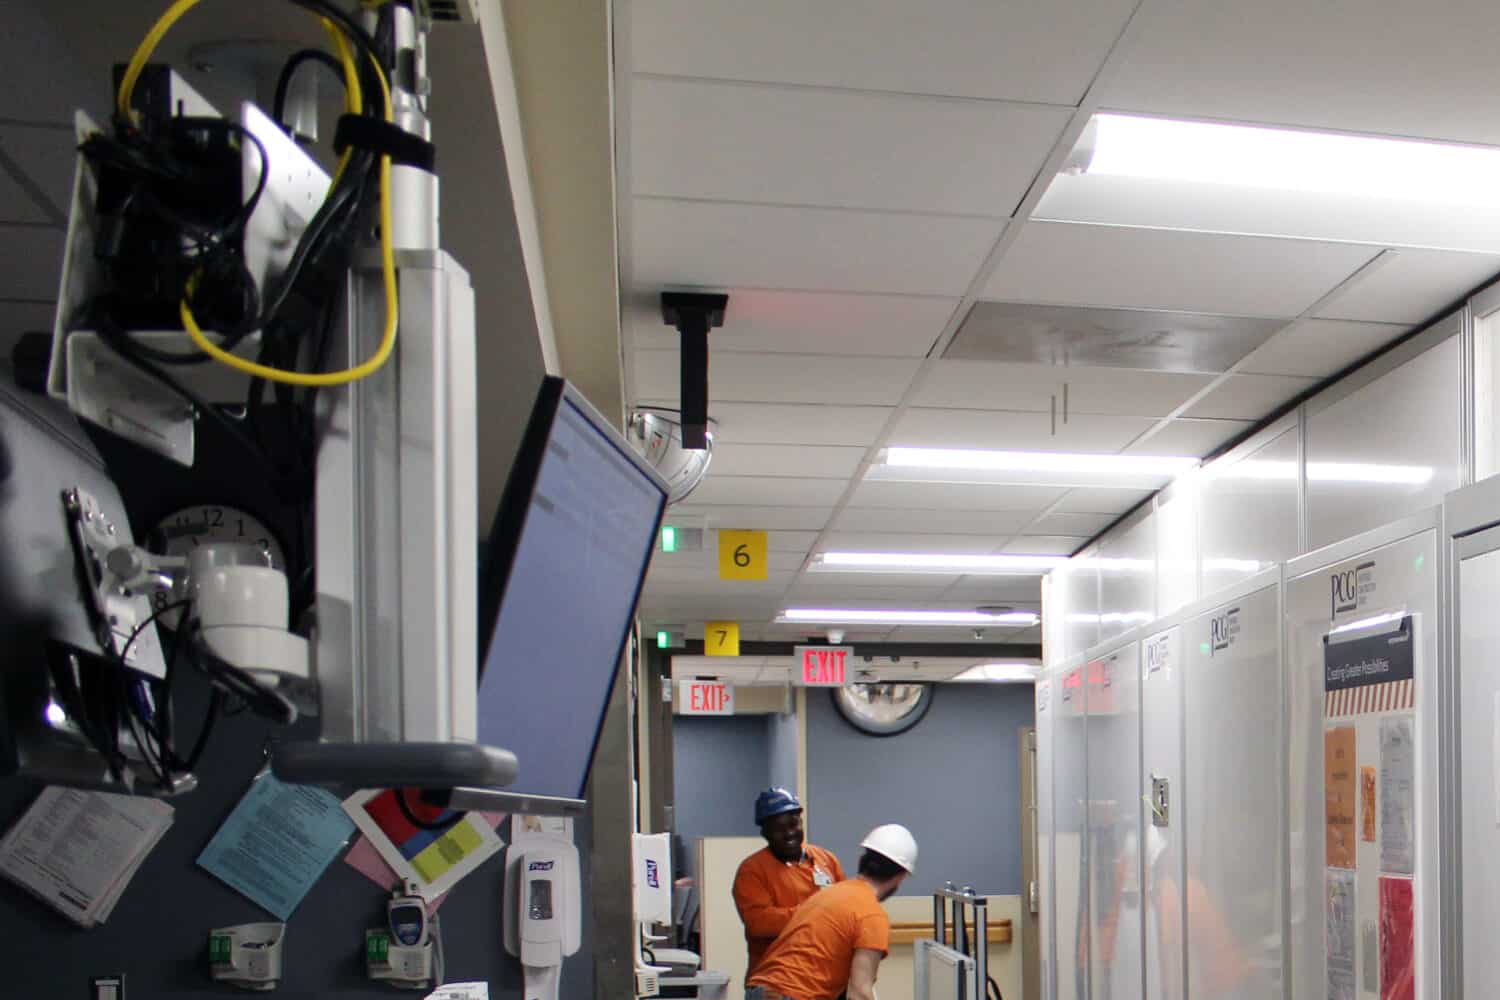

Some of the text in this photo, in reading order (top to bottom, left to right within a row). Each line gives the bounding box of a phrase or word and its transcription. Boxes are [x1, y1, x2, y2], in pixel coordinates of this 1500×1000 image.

[202, 509, 224, 527] 12
[733, 544, 751, 568] 6
[1331, 569, 1355, 622] PCG
[715, 630, 728, 647] 7
[802, 650, 848, 684] EXIT
[690, 684, 725, 712] EXIT
